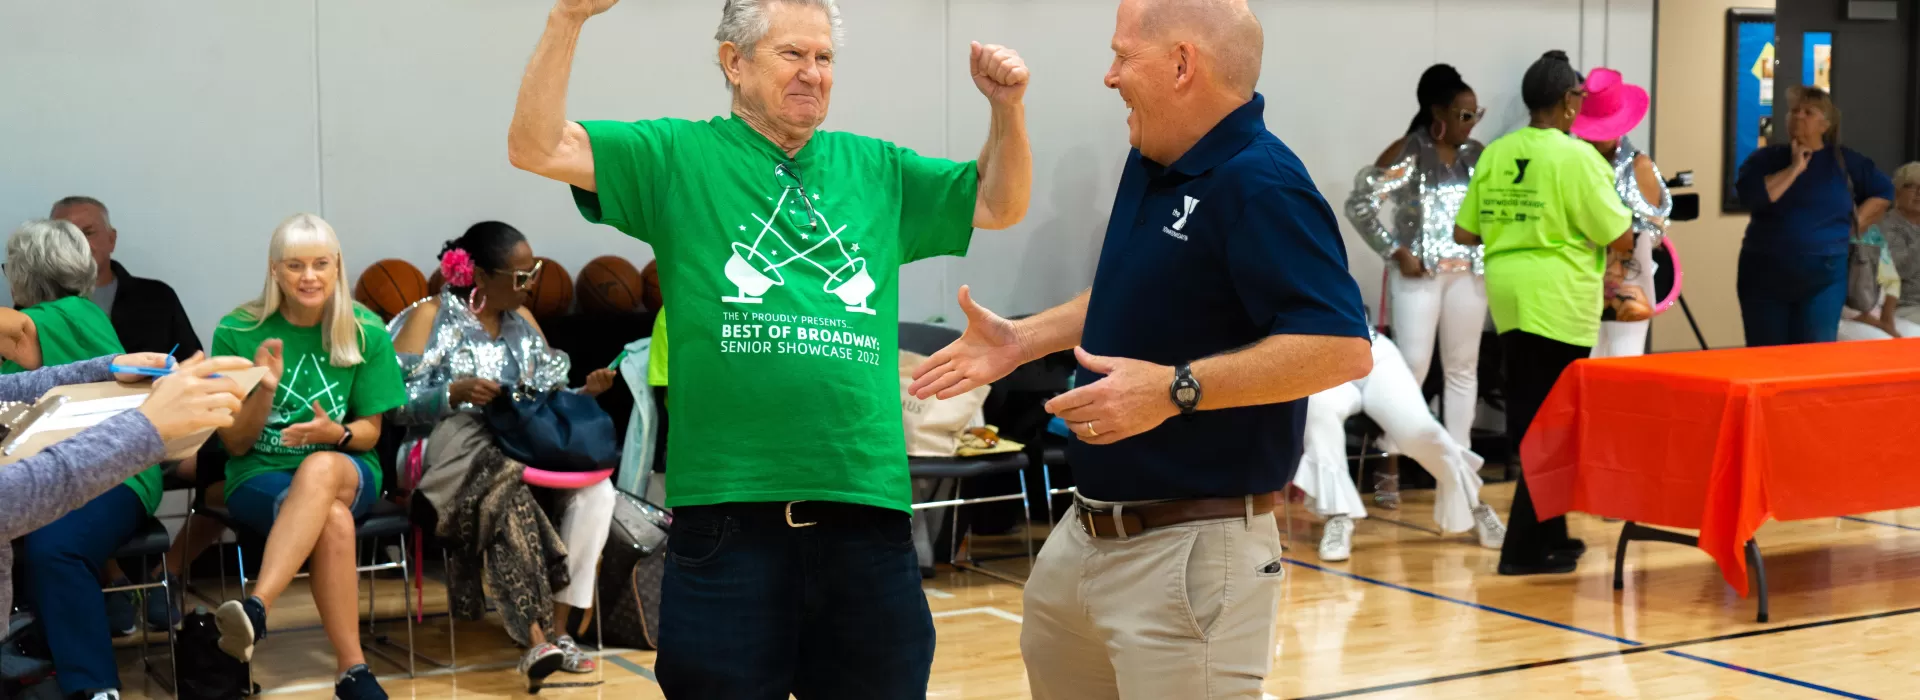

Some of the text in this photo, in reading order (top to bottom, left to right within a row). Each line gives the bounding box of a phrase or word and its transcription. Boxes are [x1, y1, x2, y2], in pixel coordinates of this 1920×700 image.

[723, 311, 739, 321] THE
[742, 312, 749, 321] Y
[752, 312, 798, 323] PROUDLY
[722, 324, 880, 351] BEST OF BROADWAY:
[720, 340, 880, 366] SENIOR SHOWCASE 2022
